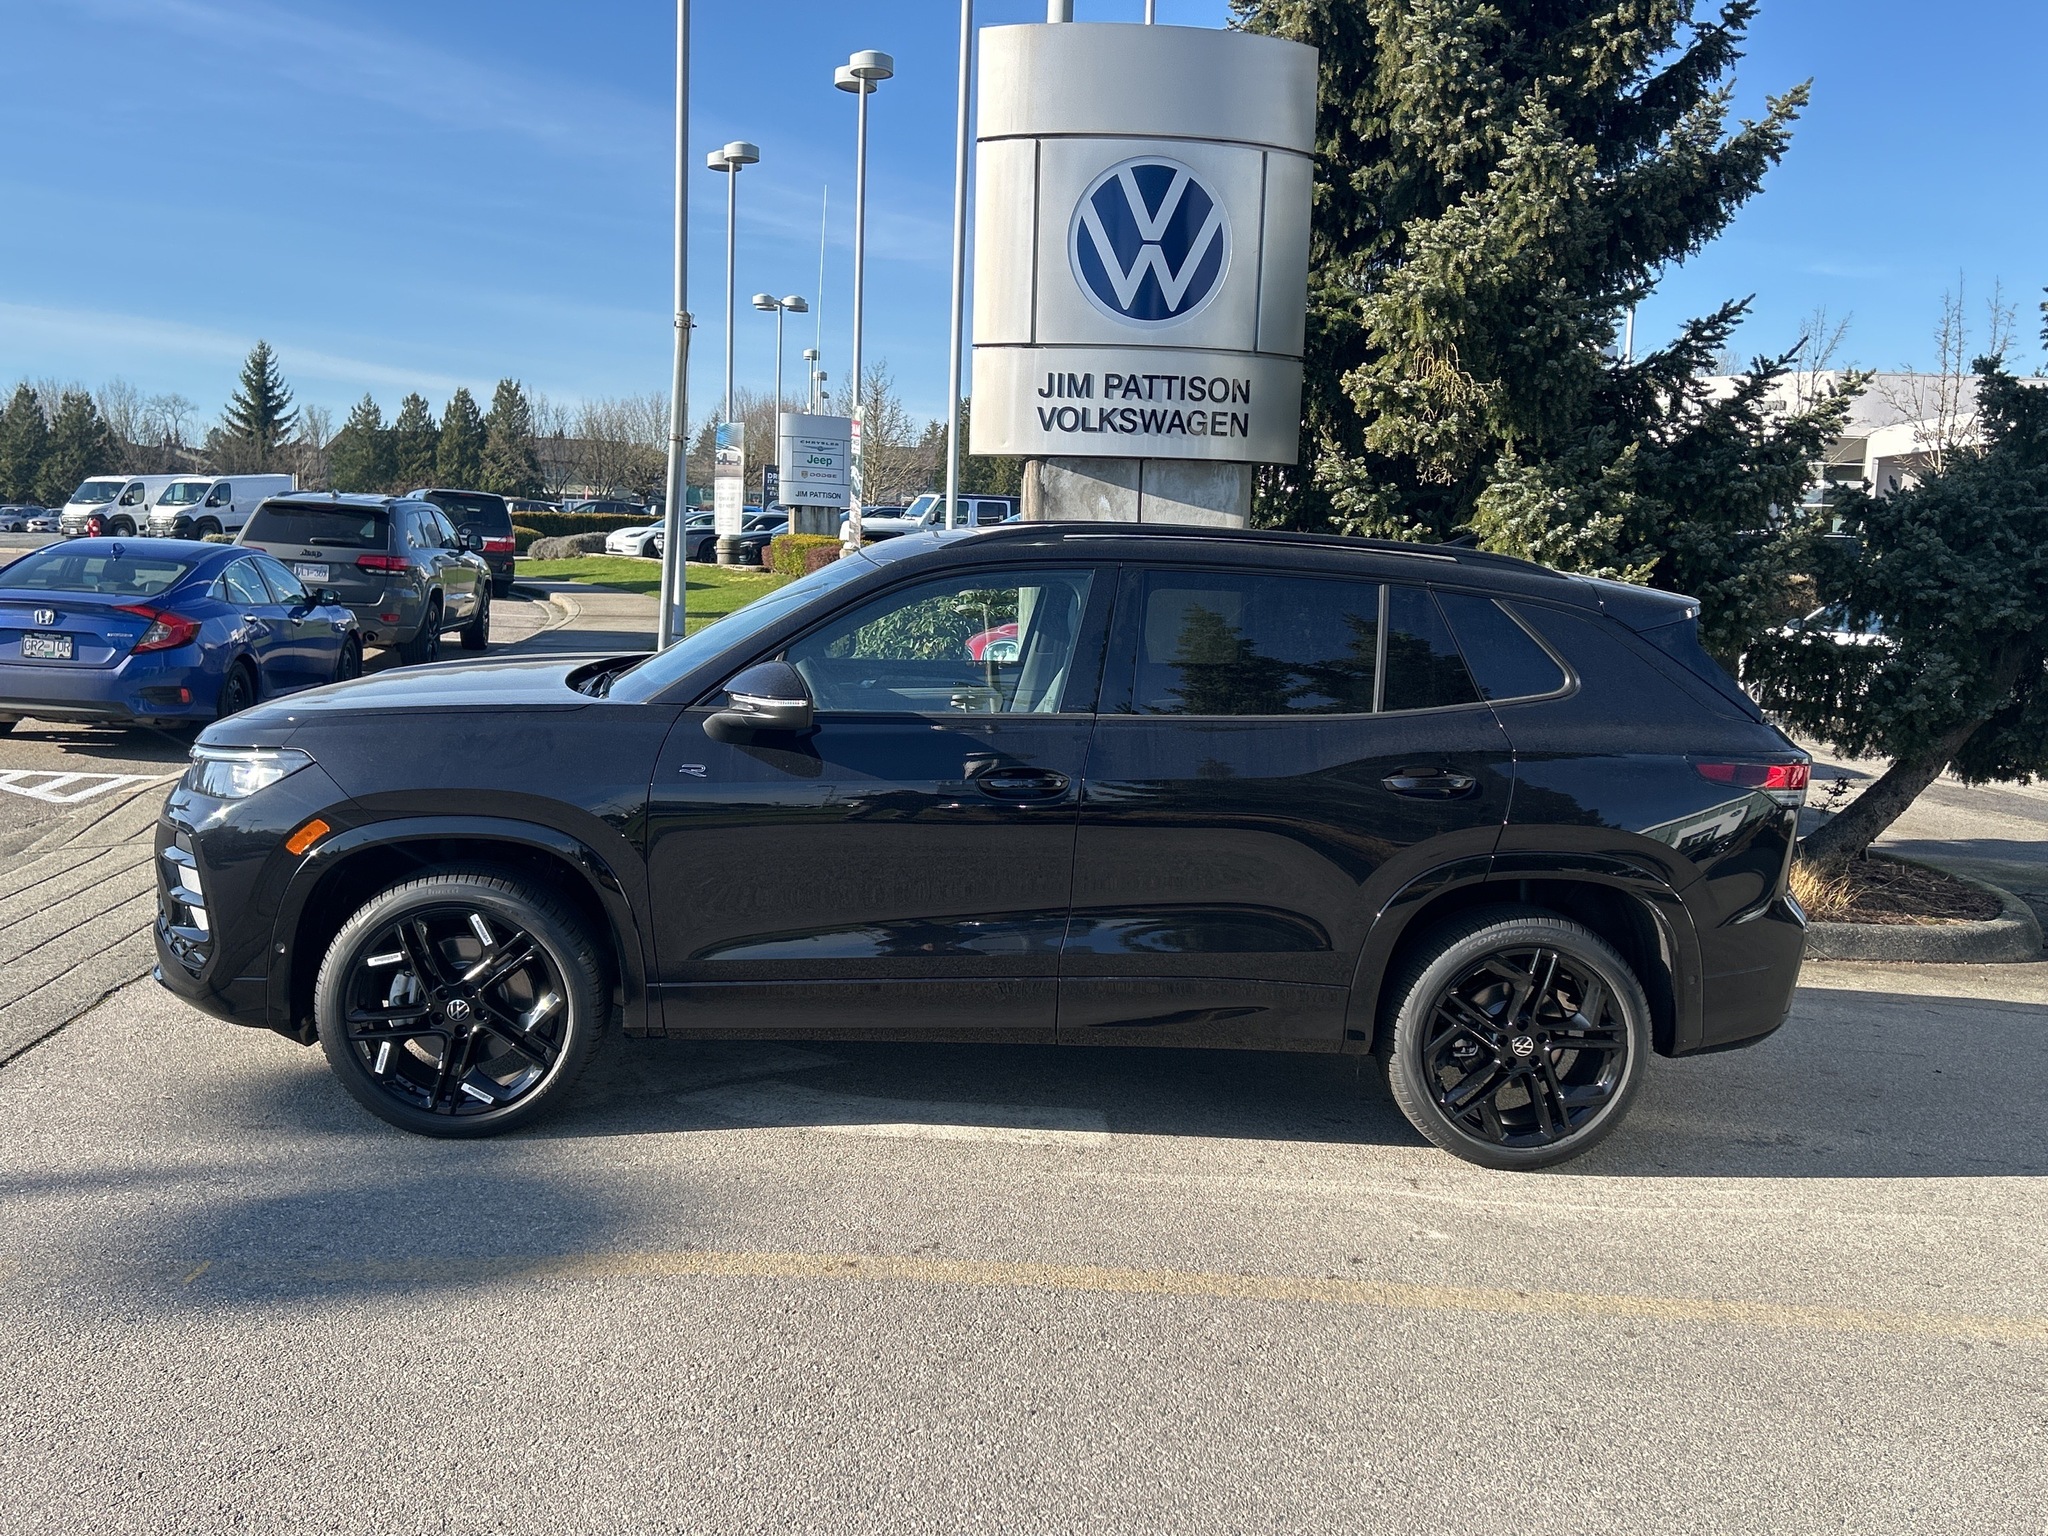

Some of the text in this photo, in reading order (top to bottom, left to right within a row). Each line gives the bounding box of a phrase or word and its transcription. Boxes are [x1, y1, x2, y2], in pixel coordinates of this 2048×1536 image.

[1038, 372, 1250, 404] JIM PATTISON
[1037, 407, 1249, 437] VOLKSWAGEN
[806, 455, 833, 467] Jeep
[809, 491, 841, 499] PATTISON
[1461, 929, 1533, 955] SCORPION
